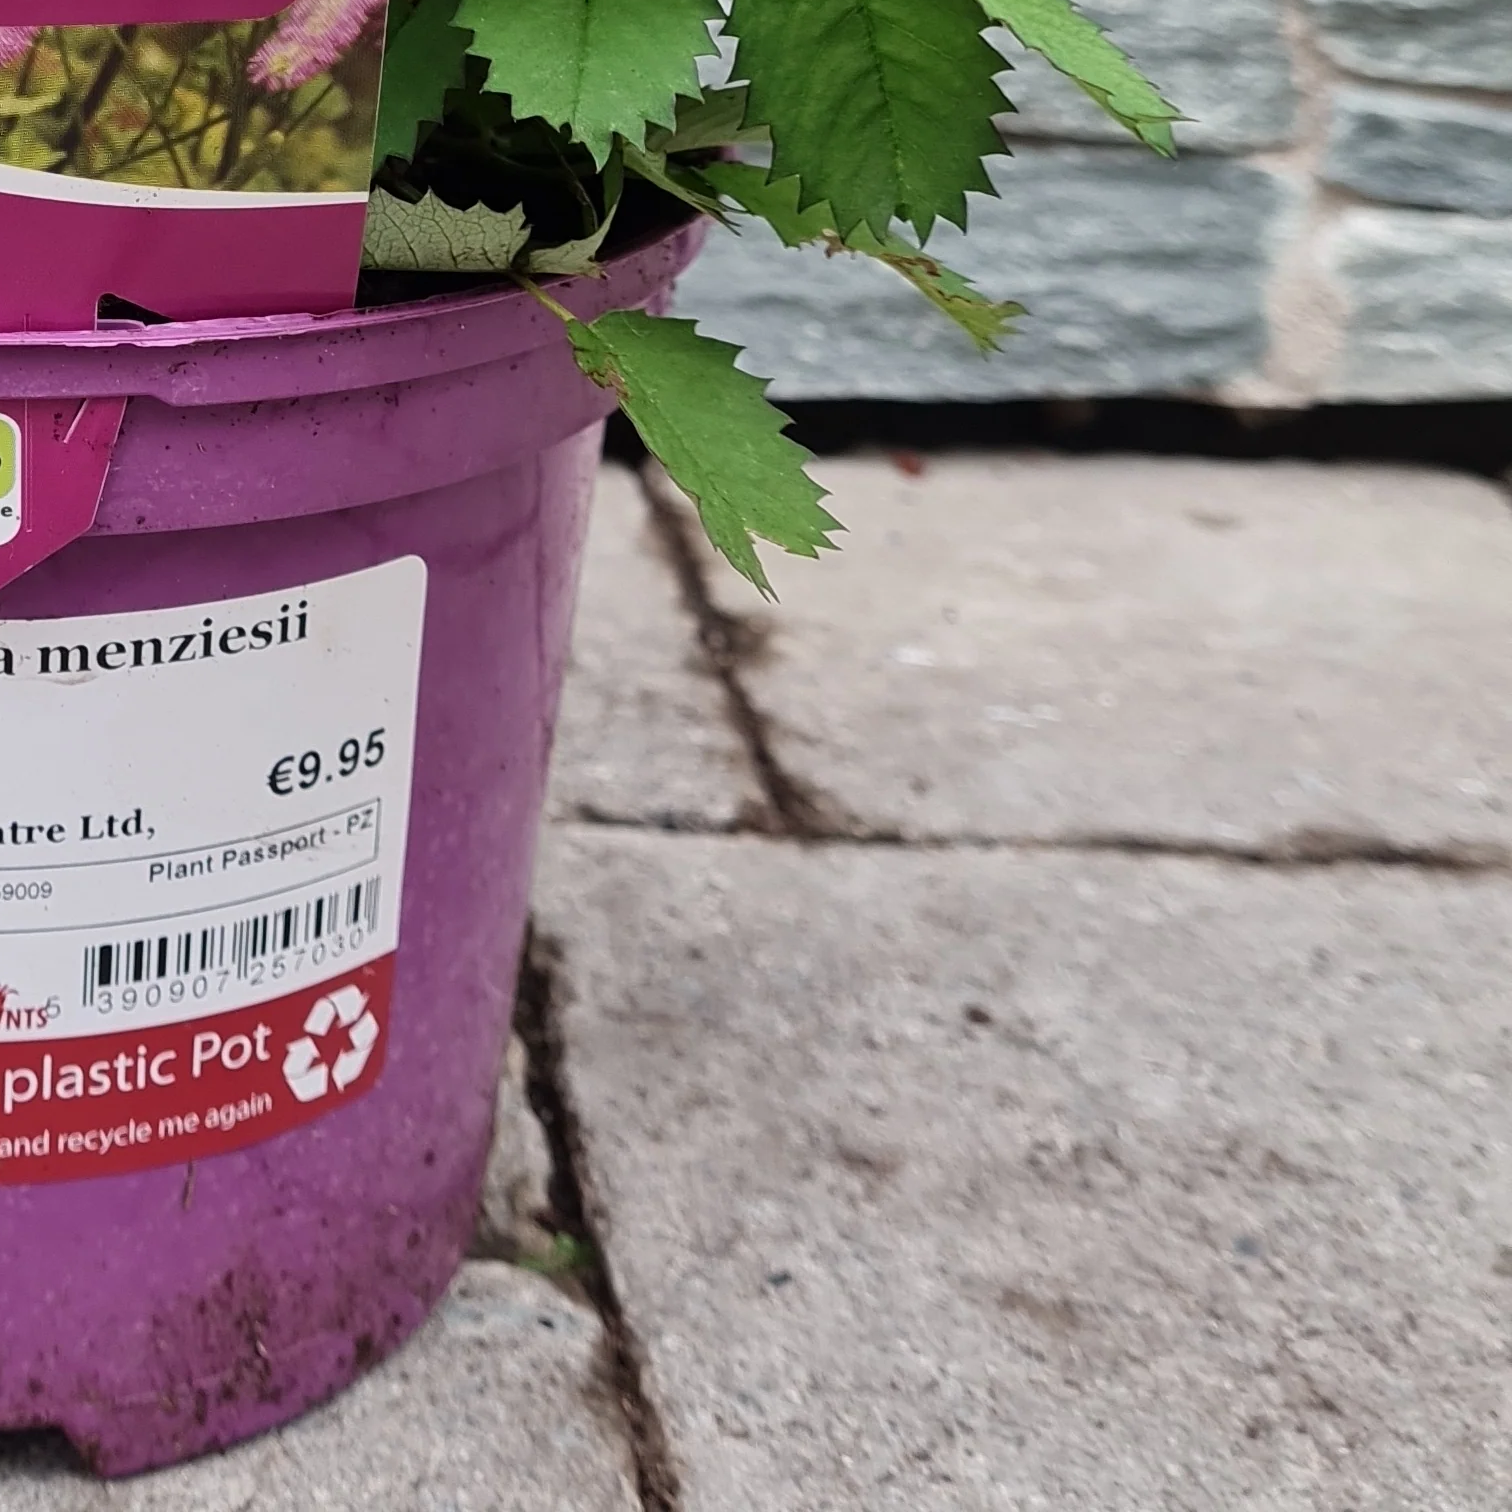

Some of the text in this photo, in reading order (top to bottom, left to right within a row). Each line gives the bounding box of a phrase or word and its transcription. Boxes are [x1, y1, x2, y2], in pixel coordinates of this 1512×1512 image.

[37, 600, 312, 676] menziesii
[266, 727, 388, 798] €9.95
[80, 809, 157, 842] Ltd,
[148, 858, 214, 883] Plant
[222, 829, 326, 869] Passport
[346, 808, 374, 834] PZ
[97, 969, 230, 1015] 390907
[249, 928, 365, 987] 257030
[2, 1042, 177, 1114] plastic
[191, 1022, 273, 1078] Pot
[57, 1118, 152, 1158] recycle
[157, 1113, 199, 1139] me
[204, 1090, 274, 1132] again
